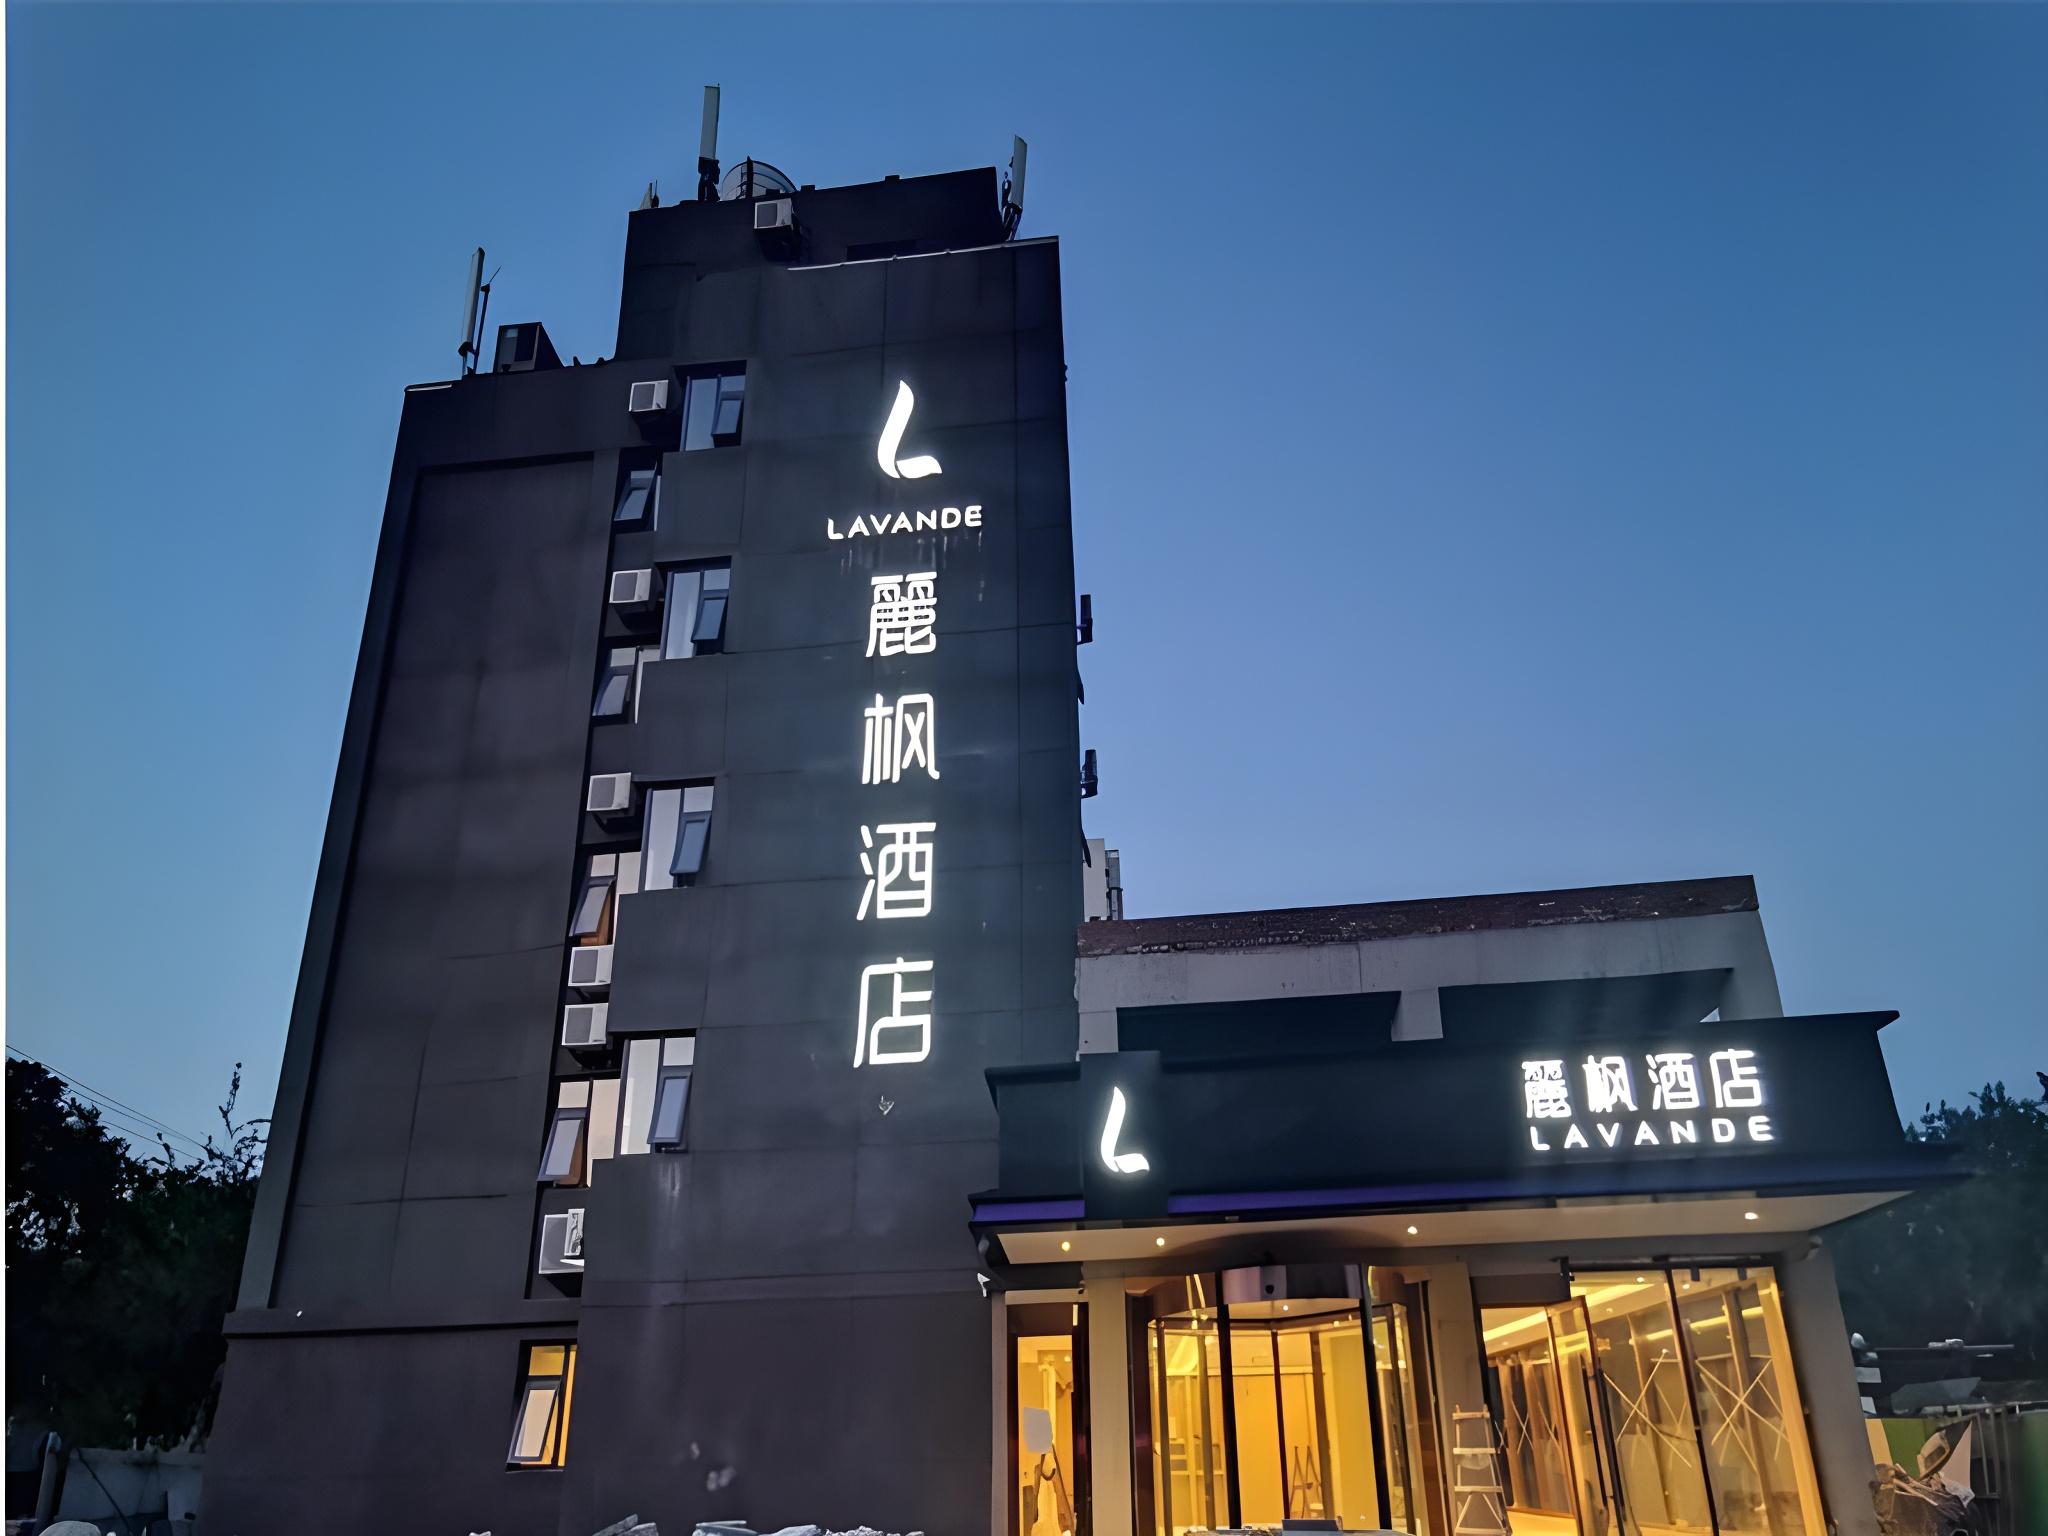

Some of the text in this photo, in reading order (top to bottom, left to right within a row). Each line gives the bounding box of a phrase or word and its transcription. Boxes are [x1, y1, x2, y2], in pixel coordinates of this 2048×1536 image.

[827, 505, 983, 540] LAVANDE
[853, 571, 940, 1068] 麗枫酒店
[1521, 1048, 1763, 1119] 麗枫酒店
[1529, 1115, 1774, 1152] LAVANDE
